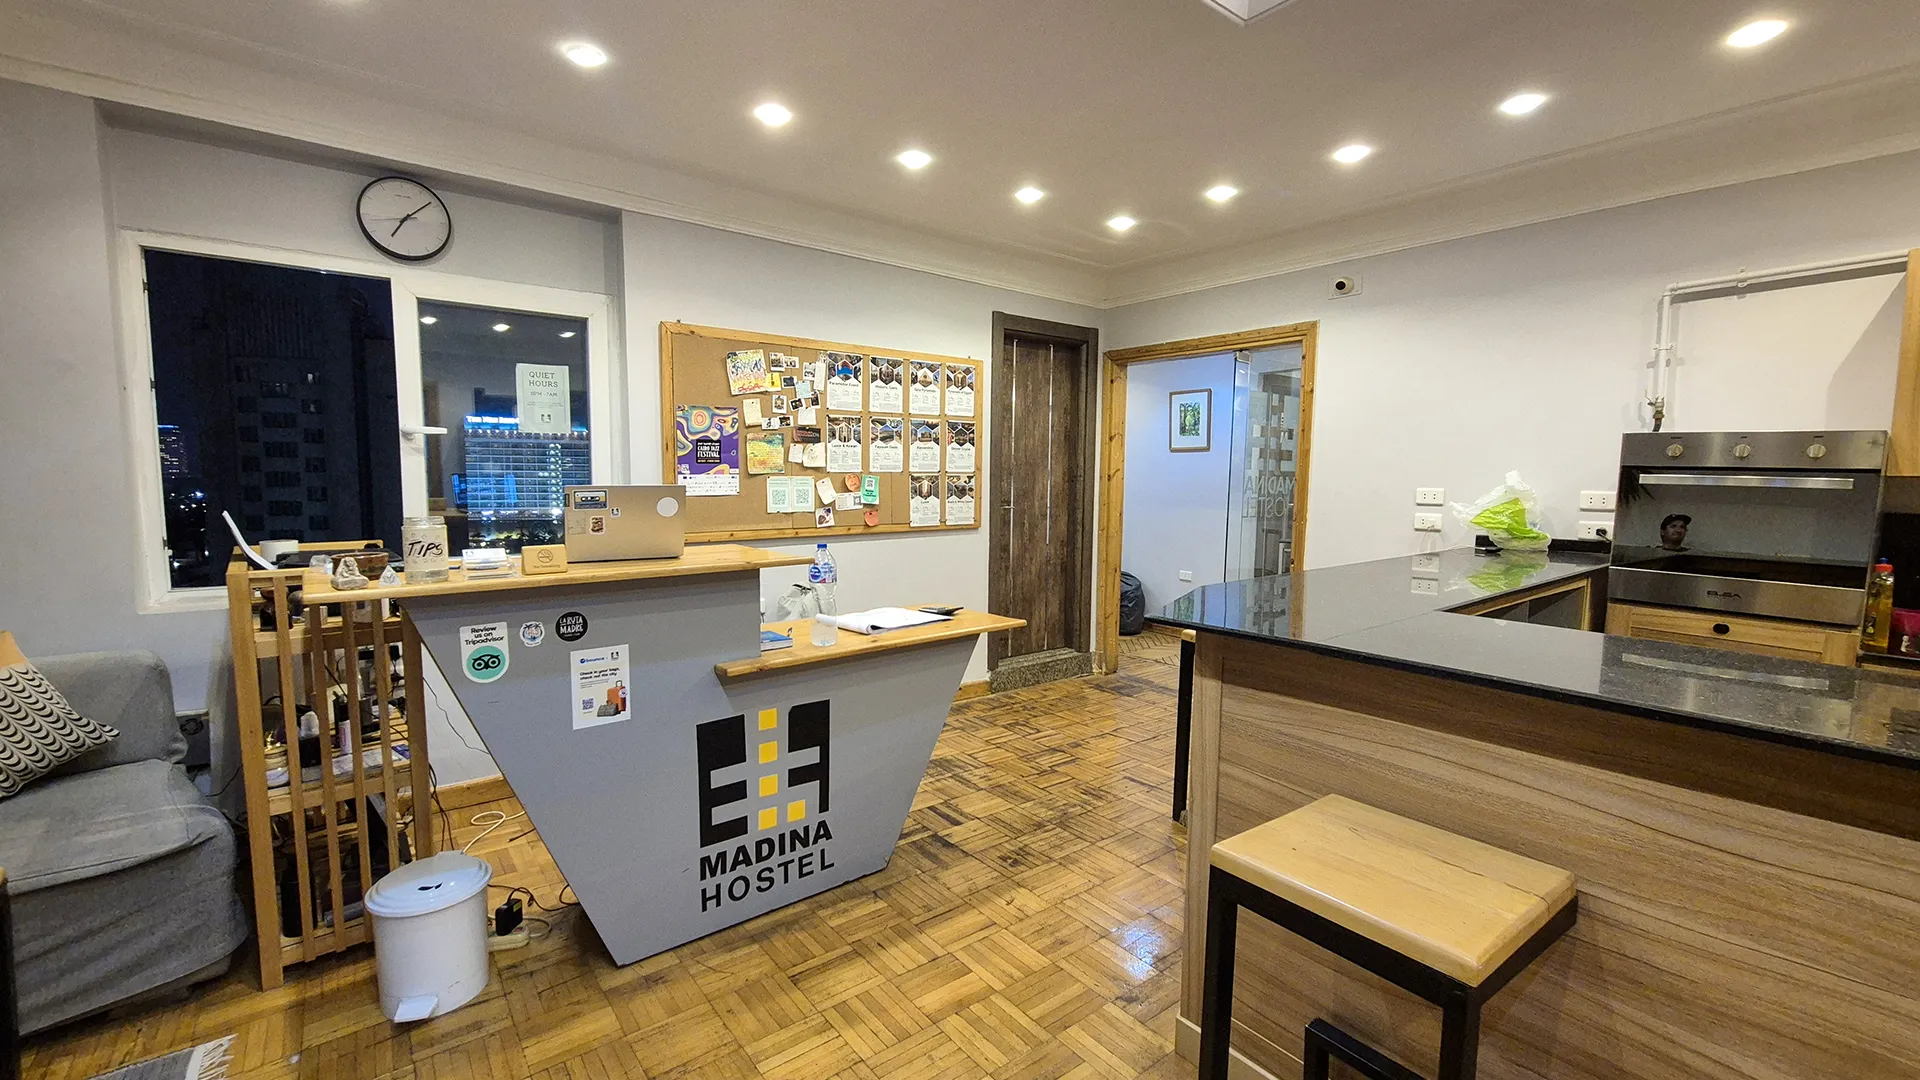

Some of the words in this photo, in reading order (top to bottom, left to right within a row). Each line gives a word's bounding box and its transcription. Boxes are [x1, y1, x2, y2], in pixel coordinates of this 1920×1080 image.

[528, 371, 555, 379] QUIET
[407, 541, 443, 557] TIPS
[560, 624, 583, 634] MADRE
[465, 636, 504, 645] Tripadvisor
[700, 820, 833, 881] MADINA
[701, 848, 834, 913] HOSTEL
